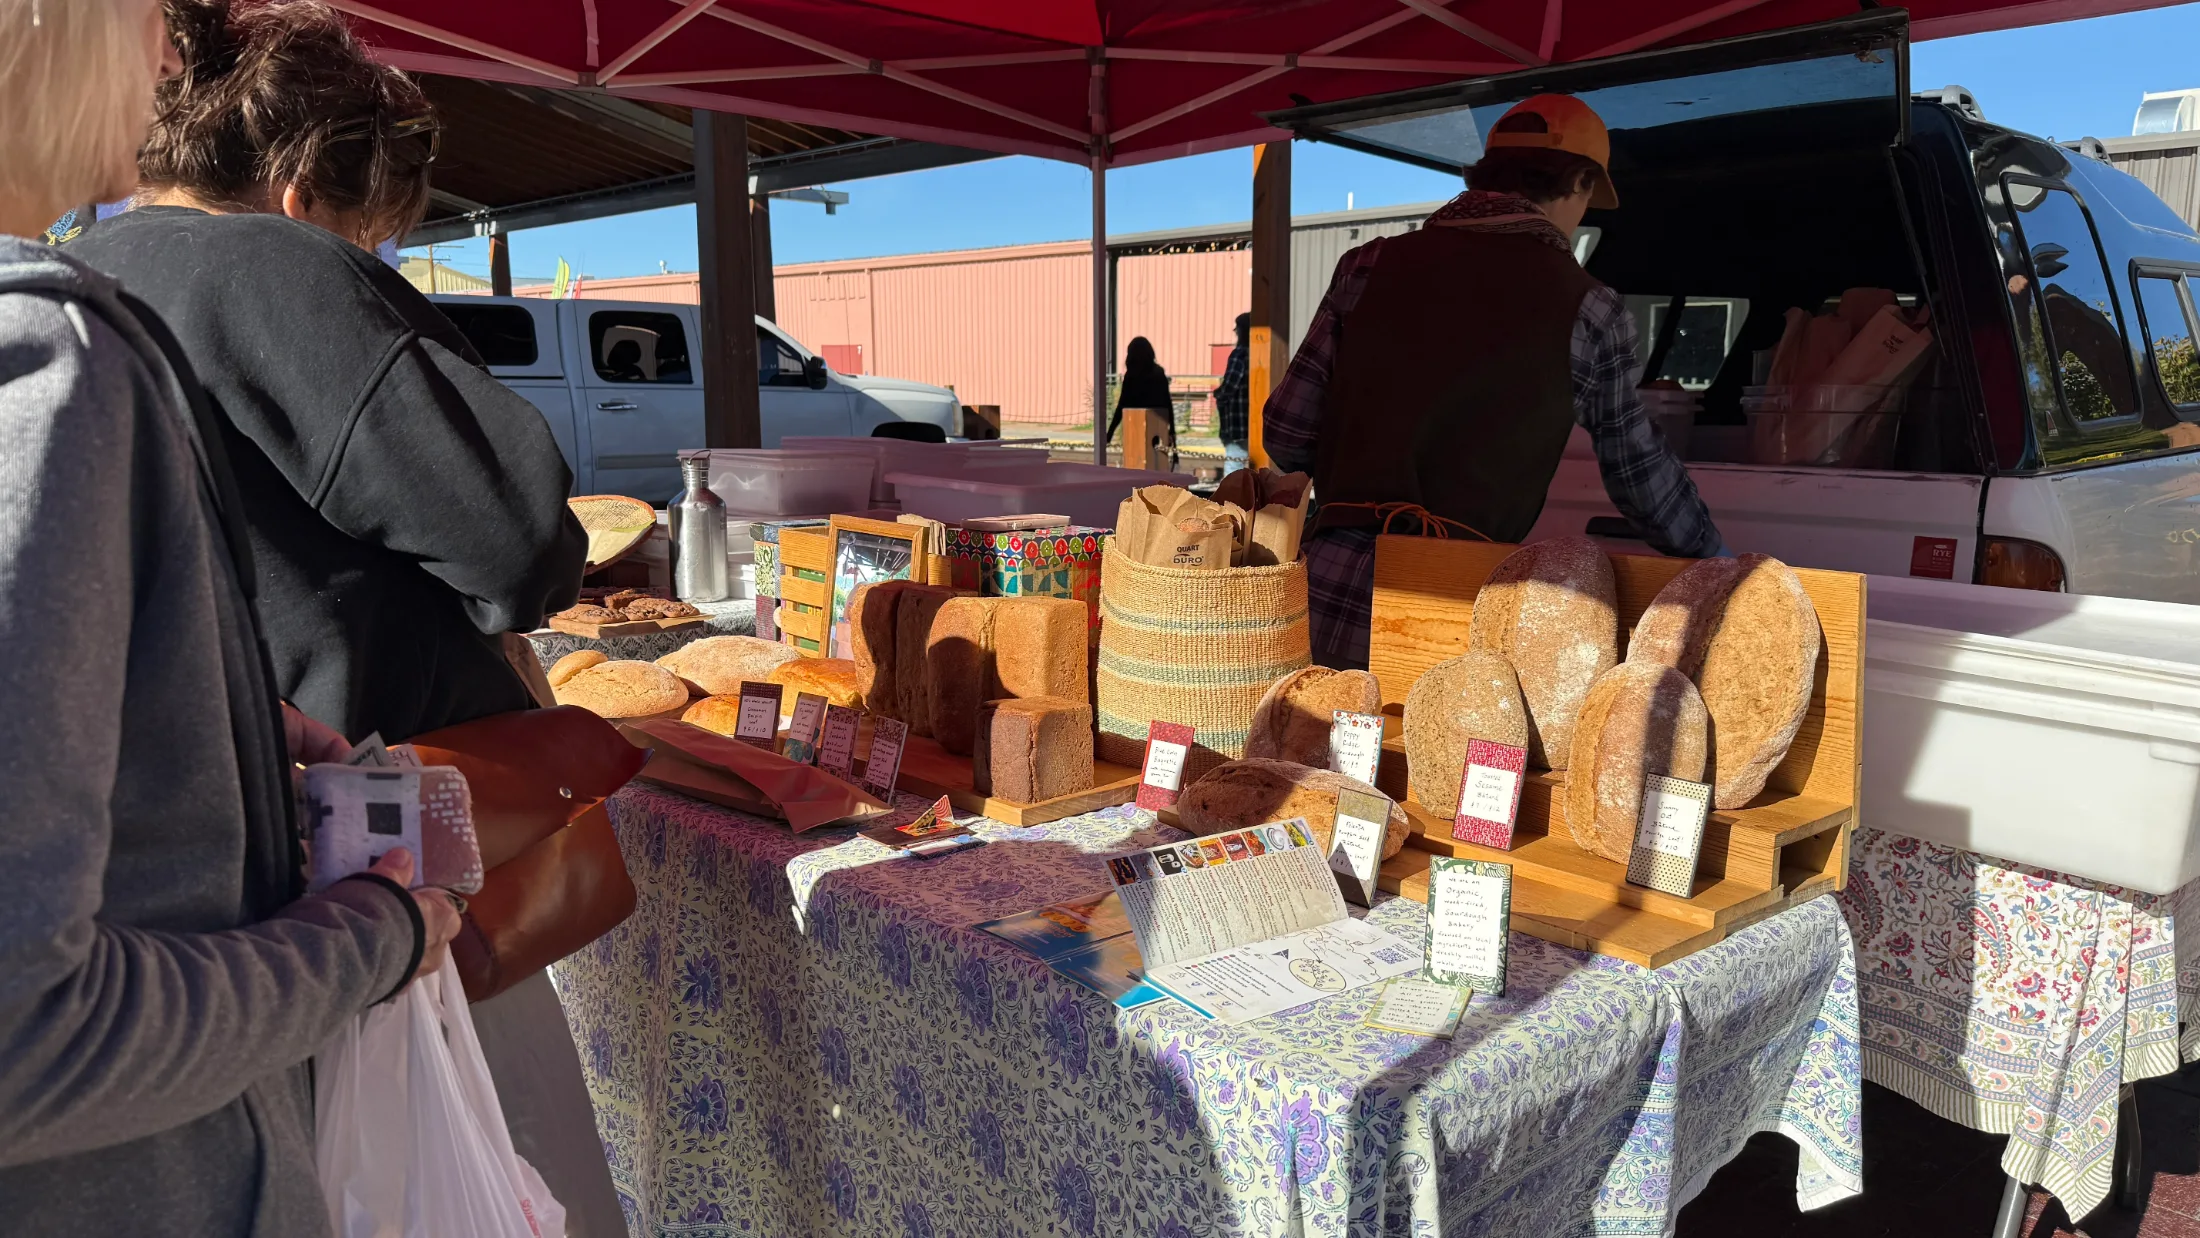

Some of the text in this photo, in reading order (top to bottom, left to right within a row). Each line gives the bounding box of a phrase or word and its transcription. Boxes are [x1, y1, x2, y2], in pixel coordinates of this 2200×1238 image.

[1176, 544, 1200, 553] QUART
[1932, 549, 1952, 558] RYE
[1173, 555, 1204, 564] DURO
[1343, 730, 1360, 740] Poppy
[1474, 780, 1503, 791] Sesame
[1657, 801, 1679, 815] Sunny
[1446, 886, 1483, 899] Organic,
[1445, 909, 1487, 922] Sourdough
[1448, 921, 1474, 931] Bakery
